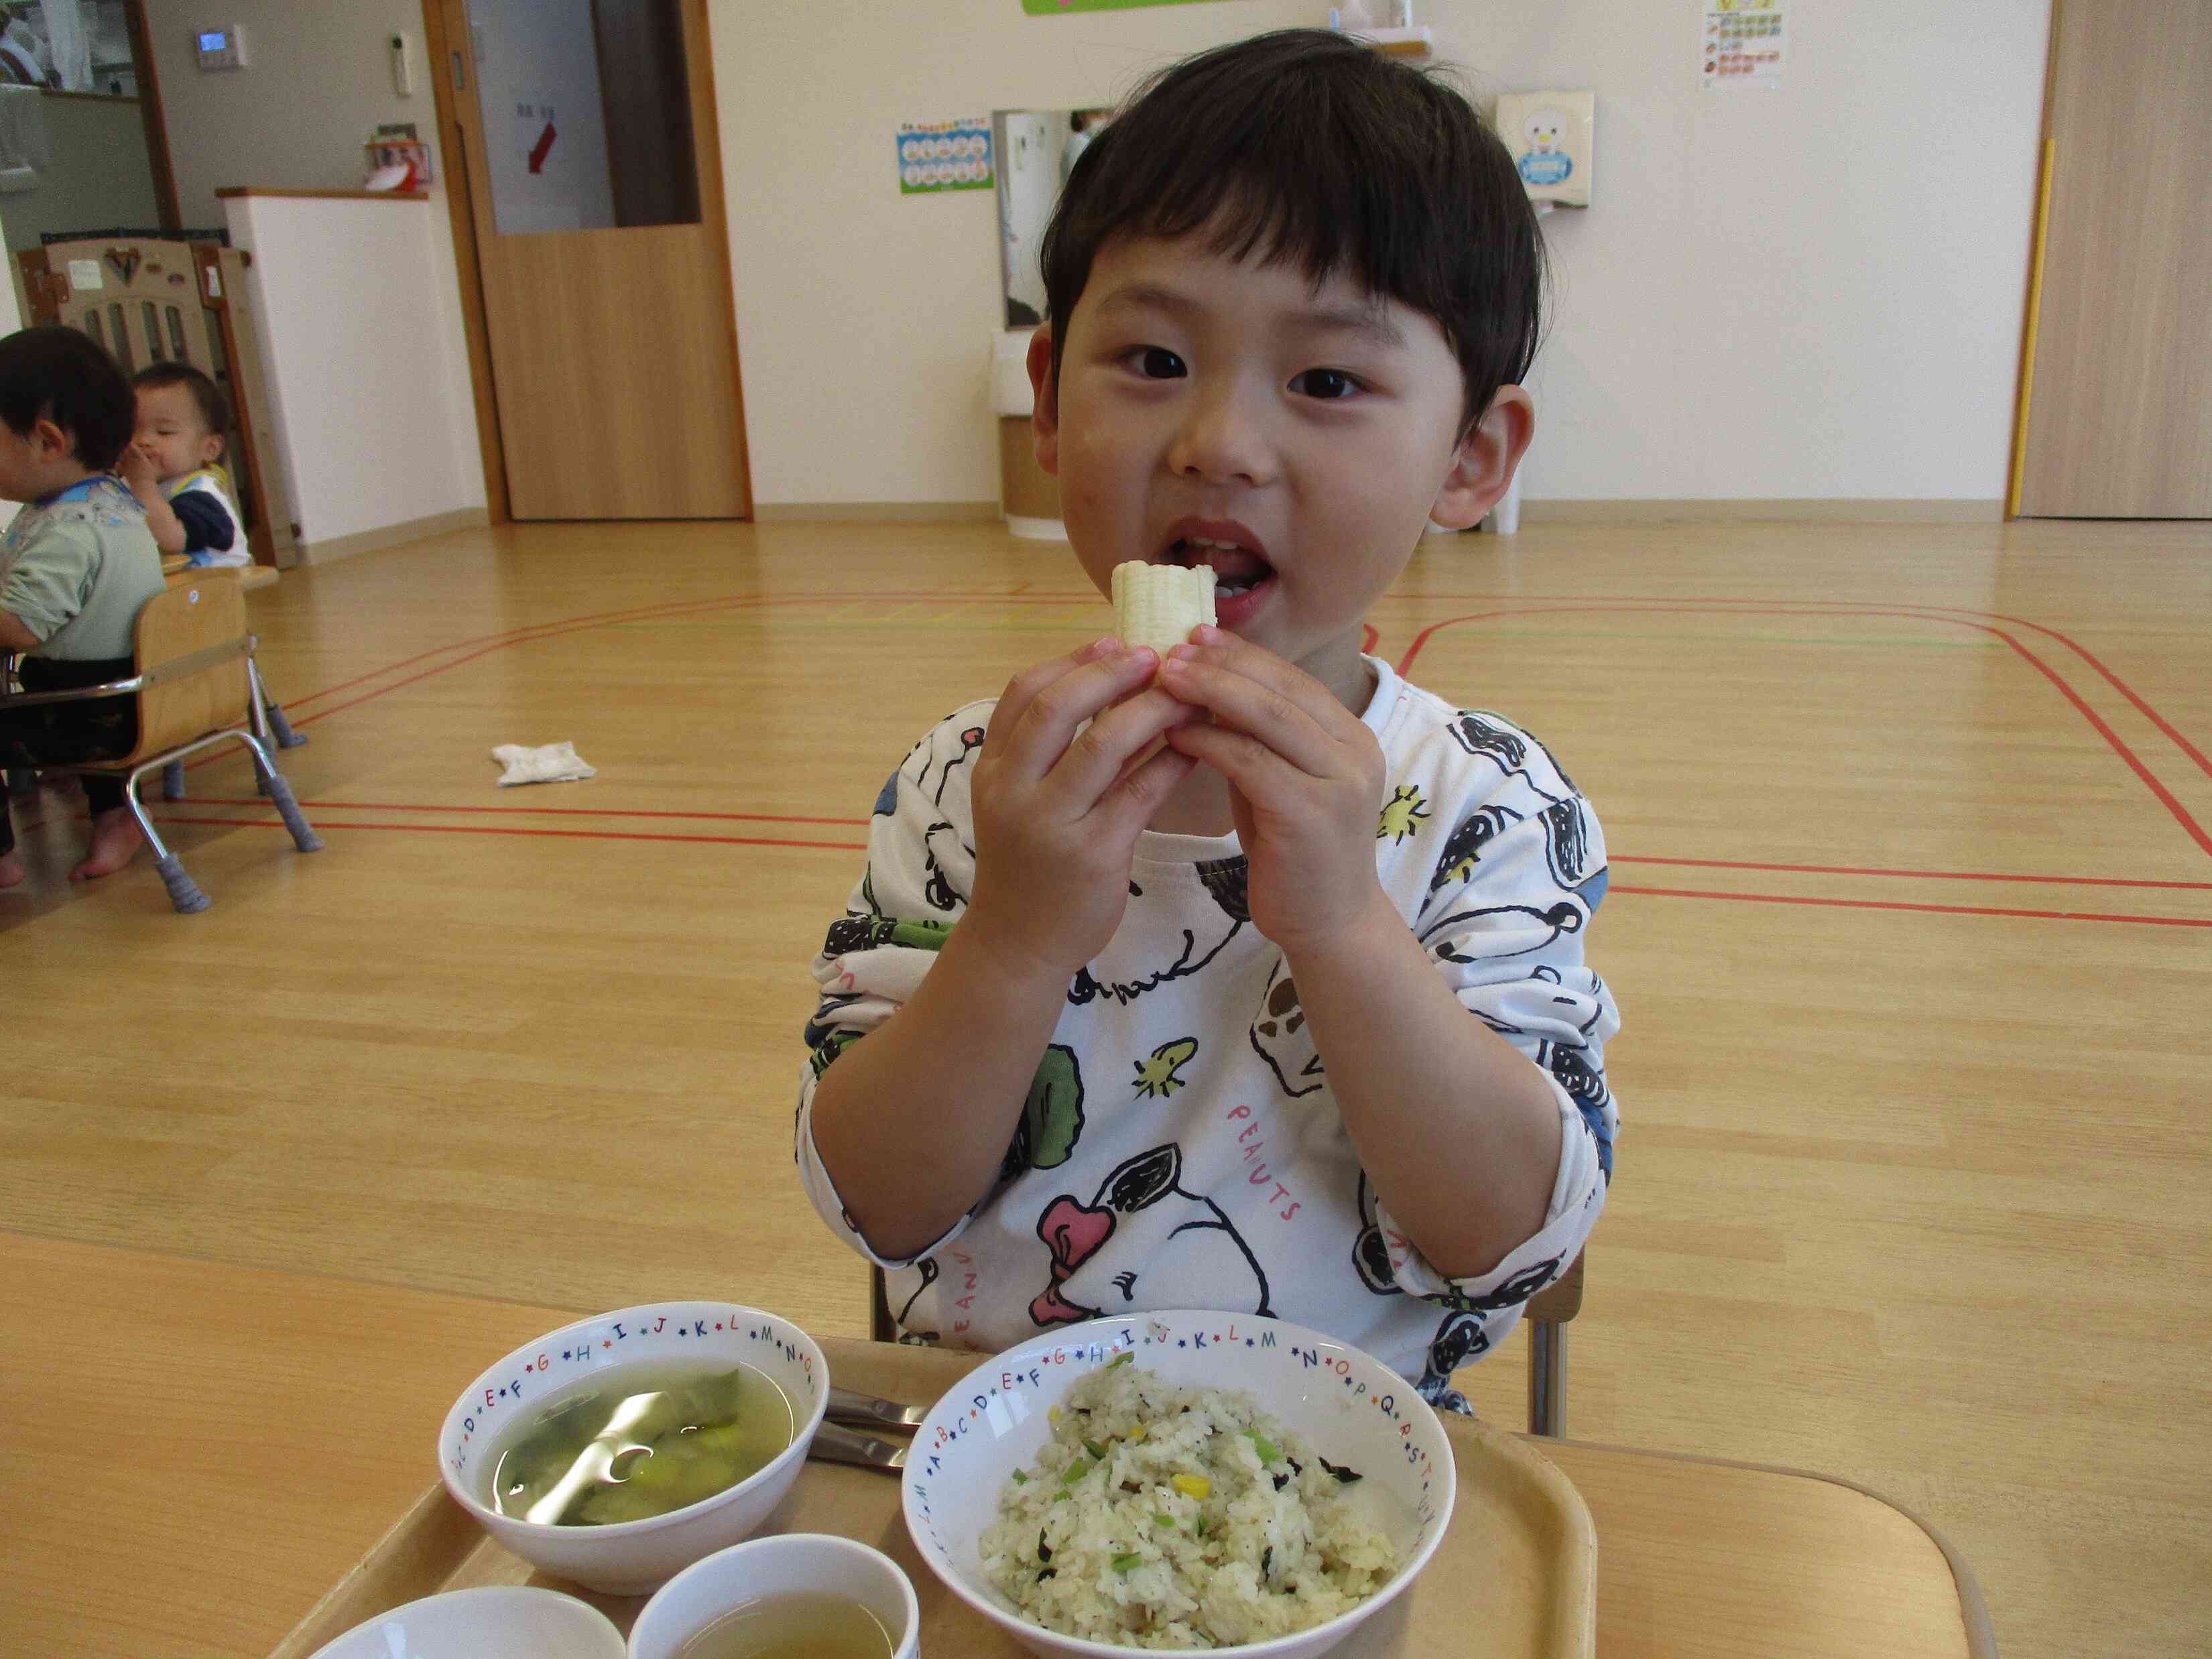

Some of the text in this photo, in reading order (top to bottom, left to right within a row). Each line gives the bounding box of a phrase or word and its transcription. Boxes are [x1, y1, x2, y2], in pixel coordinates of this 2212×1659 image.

[464, 1418, 475, 1432] D
[485, 1389, 495, 1407] E
[510, 1379, 521, 1398] F
[538, 1353, 549, 1371] G
[577, 1345, 590, 1362] H
[613, 1323, 627, 1340] I
[654, 1317, 667, 1333] J
[694, 1320, 708, 1337] K
[729, 1314, 739, 1330] L
[761, 1325, 773, 1341] M
[786, 1344, 796, 1362] N
[929, 1455, 940, 1470] A
[936, 1426, 948, 1442] B
[958, 1417, 968, 1434] C
[973, 1395, 987, 1410] D
[1001, 1372, 1011, 1390] E
[1029, 1368, 1040, 1388] F
[1054, 1347, 1065, 1365] G
[1090, 1346, 1103, 1363] H
[1121, 1329, 1135, 1346] I
[1194, 1331, 1207, 1349] K
[1229, 1325, 1239, 1341] L
[1261, 1331, 1276, 1347] M
[1302, 1349, 1318, 1368] N
[1335, 1360, 1349, 1374] O
[1354, 1383, 1366, 1395] P
[1381, 1395, 1394, 1416] Q
[1408, 1447, 1419, 1463] S
